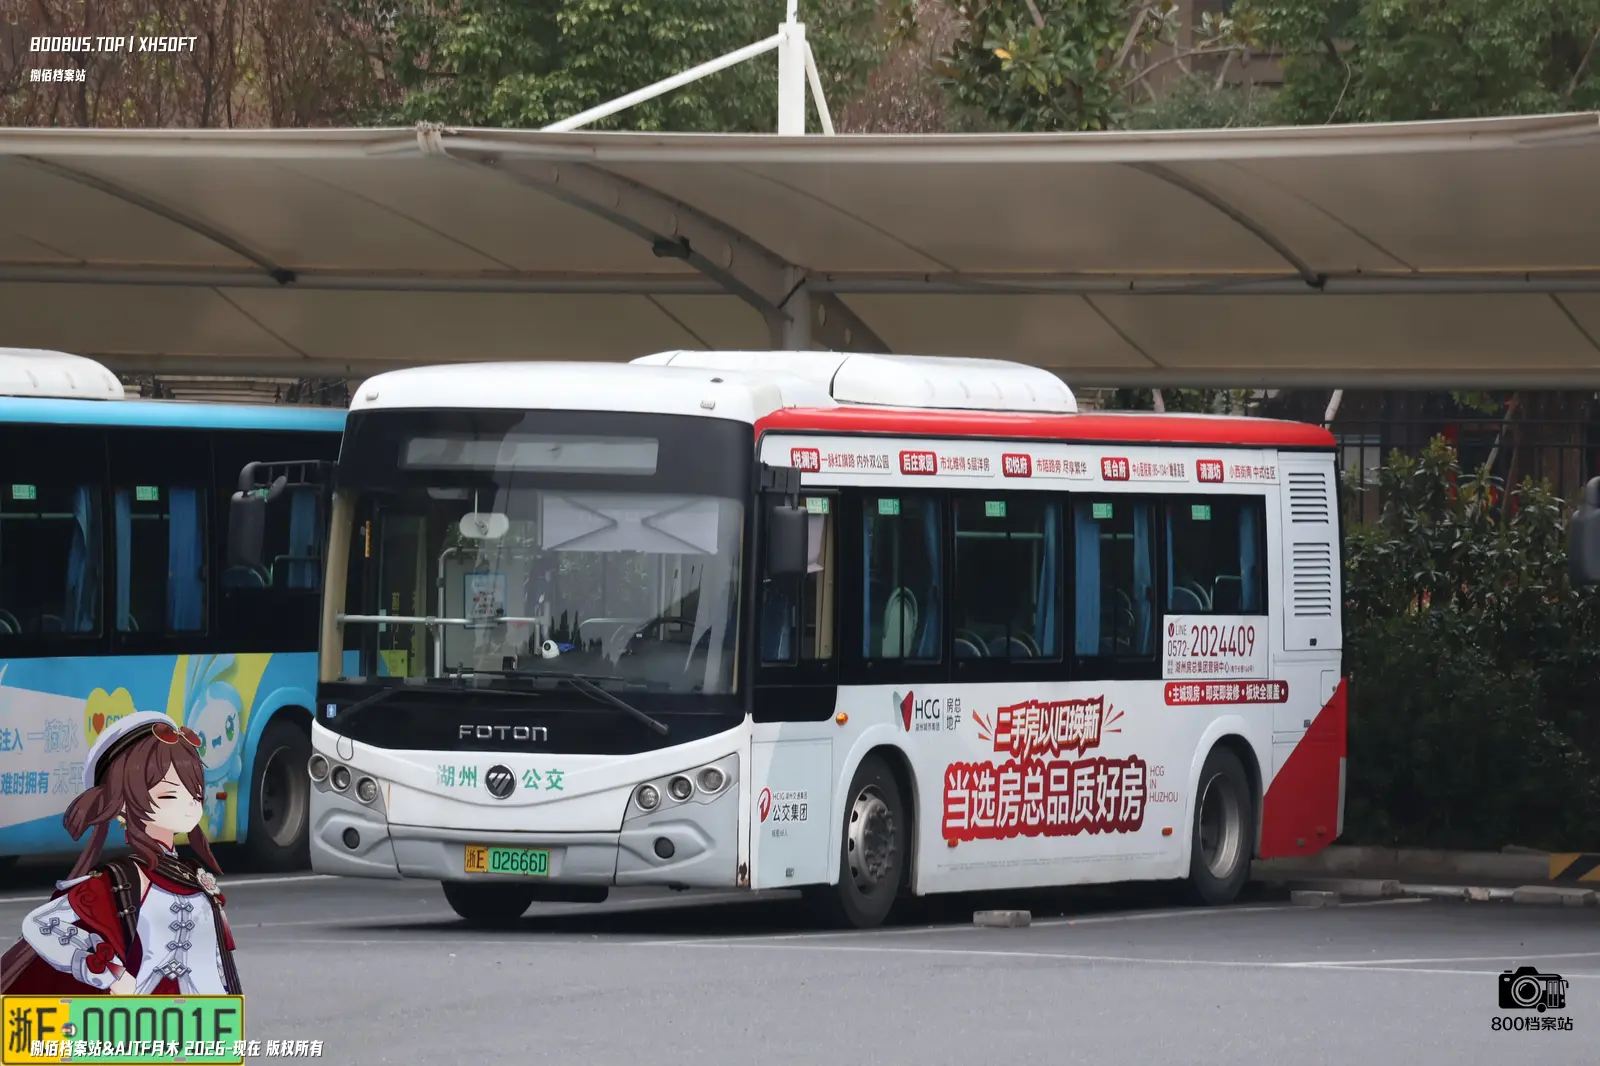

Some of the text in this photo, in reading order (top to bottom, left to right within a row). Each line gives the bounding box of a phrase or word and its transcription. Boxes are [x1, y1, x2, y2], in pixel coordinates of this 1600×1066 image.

[903, 453, 934, 472] 后庄家园
[1175, 625, 1187, 636] LINE
[915, 698, 940, 720] HCG
[27, 718, 80, 753] 一滴水
[459, 725, 548, 741] FOTON
[996, 702, 1101, 758] 二手房以旧换新
[436, 765, 565, 791] 湖州 公交
[1150, 766, 1165, 777] HCG
[0, 771, 49, 795] 难时拥有
[945, 762, 1145, 830] 当选房总品质好房
[1150, 791, 1179, 803] HUZHOU
[772, 803, 808, 822] 公交集团
[466, 849, 547, 873] 浙E 02666D
